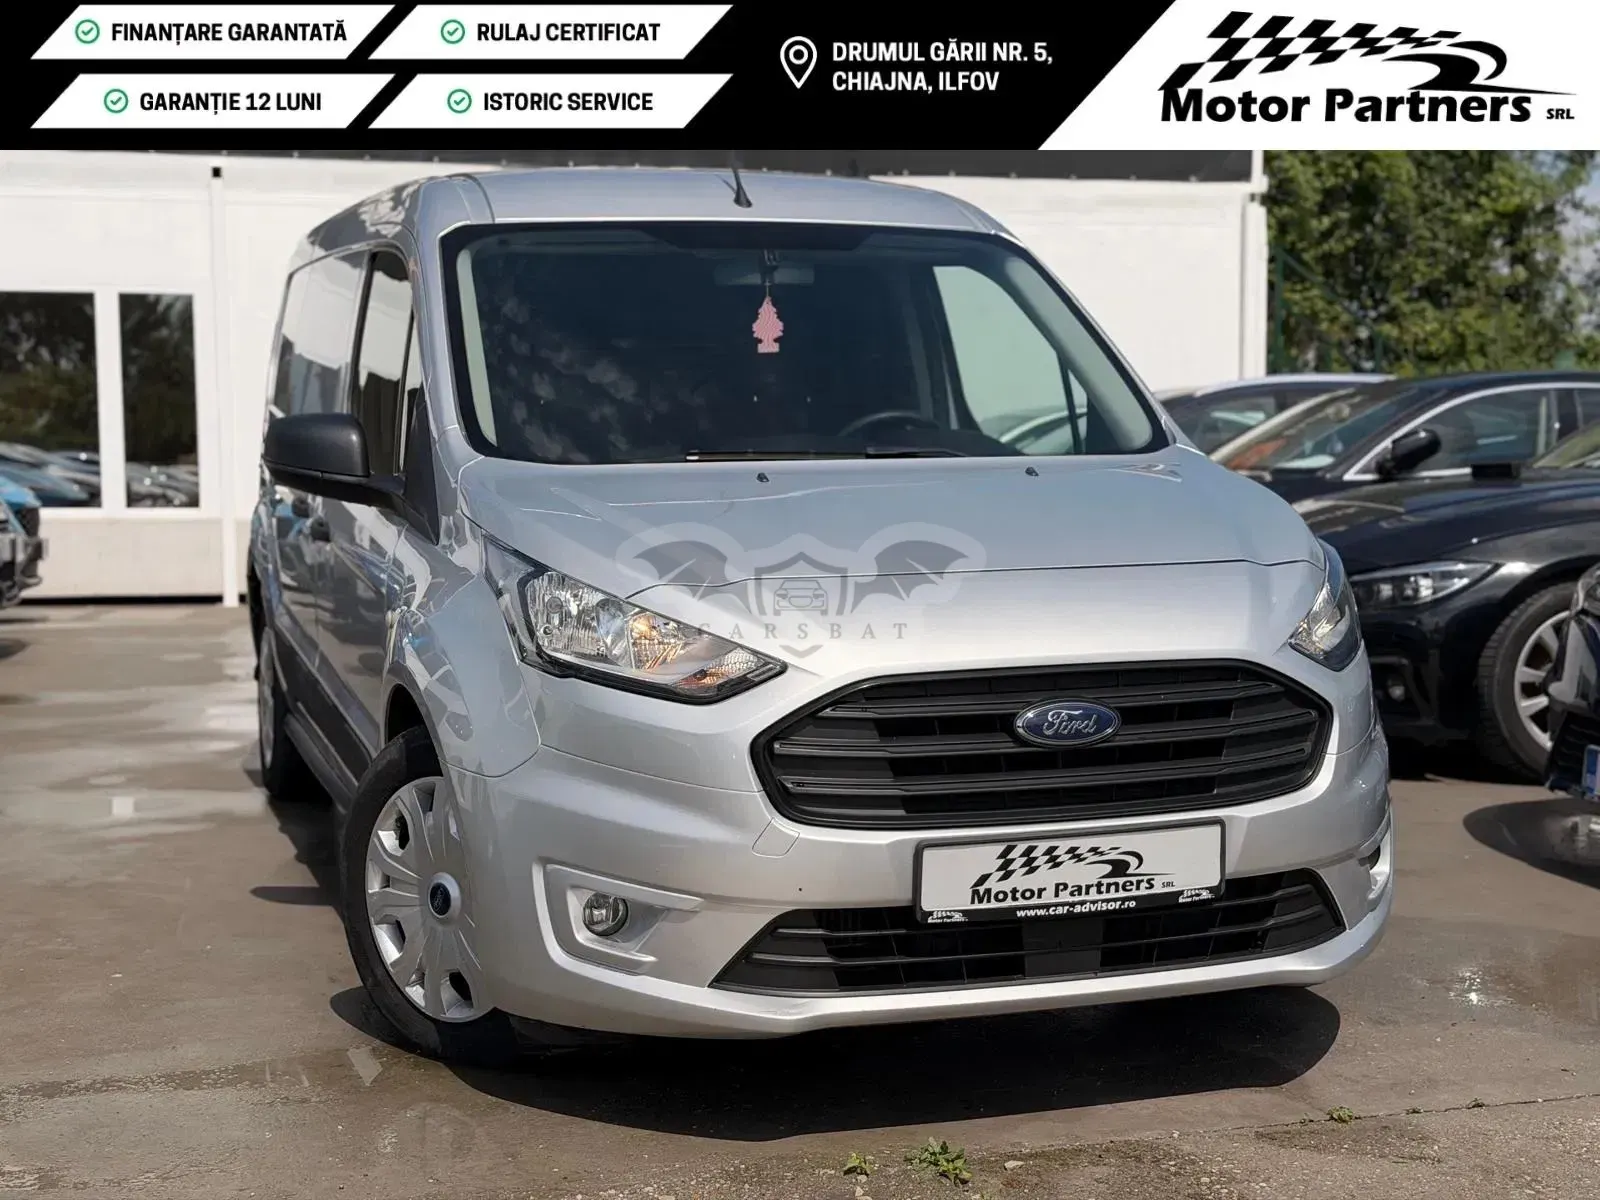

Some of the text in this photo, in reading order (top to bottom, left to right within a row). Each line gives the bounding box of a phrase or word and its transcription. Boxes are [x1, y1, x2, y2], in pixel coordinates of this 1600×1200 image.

[1043, 709, 1097, 735] Ford
[970, 877, 1176, 905] Motor Partners SRL
[1016, 900, 1136, 918] www.car-advisor.ro
